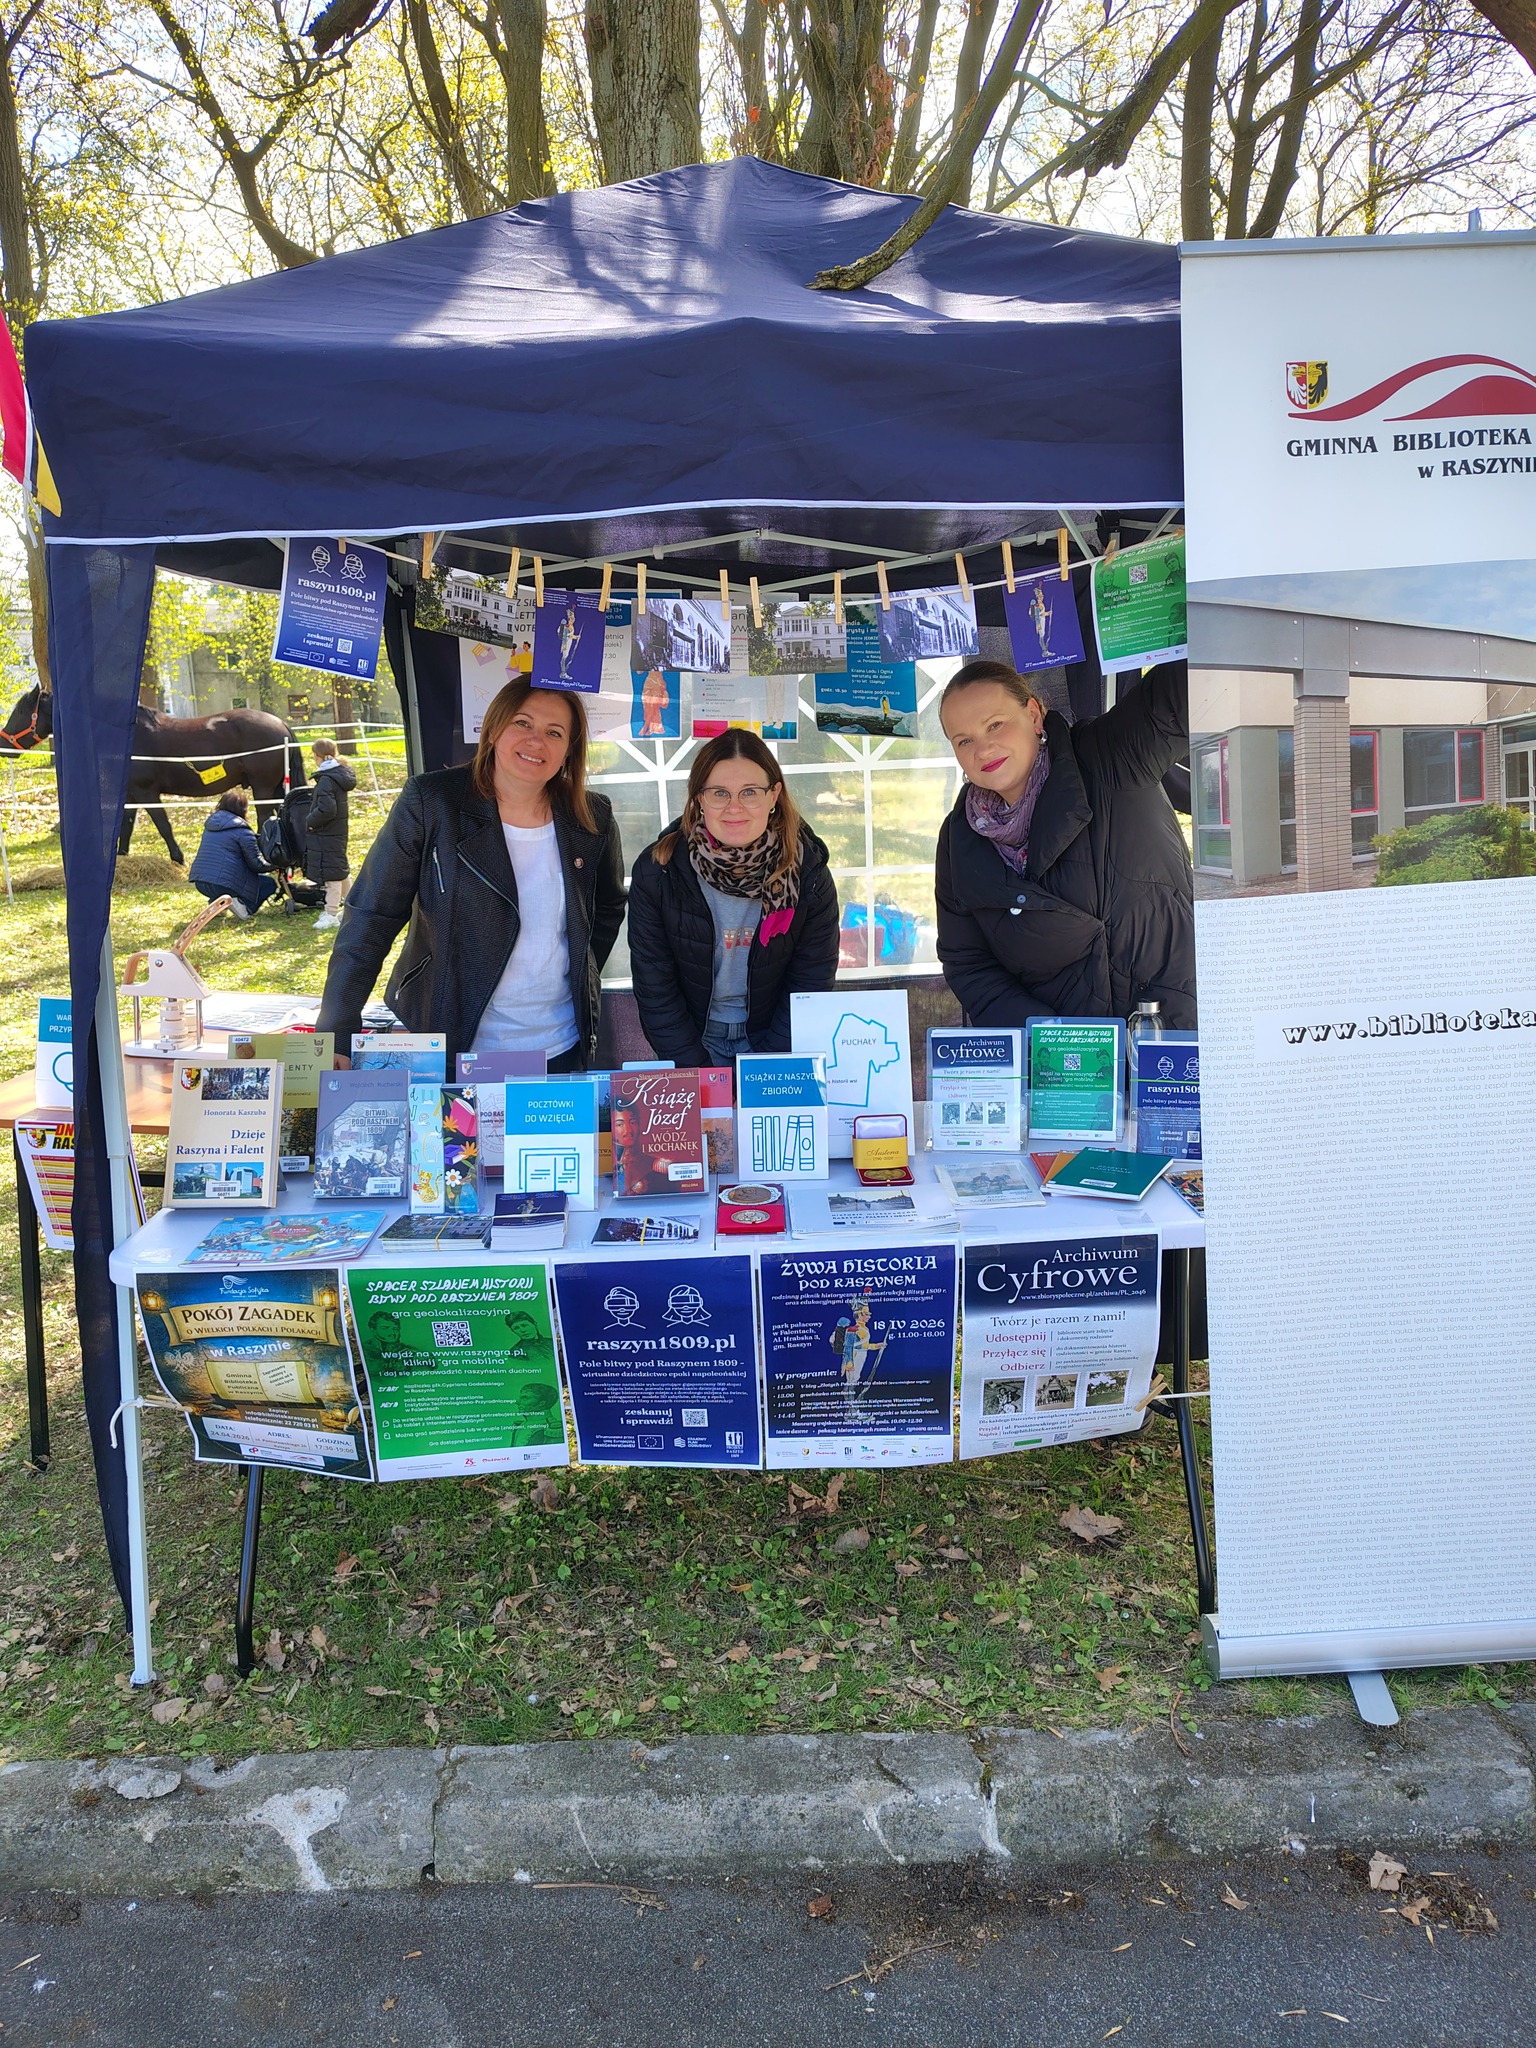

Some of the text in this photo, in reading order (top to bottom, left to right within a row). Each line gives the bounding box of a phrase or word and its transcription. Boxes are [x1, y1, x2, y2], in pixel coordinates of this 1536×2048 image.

[1287, 428, 1532, 456] GMINNA BIBLIOTEKA
[1418, 466, 1434, 478] w
[1111, 560, 1120, 569] gra
[298, 577, 376, 602] raszyn1809.pl
[303, 594, 319, 603] bitwy
[320, 597, 331, 605] pod
[333, 601, 360, 612] Raszynem
[307, 632, 334, 643] zeskanuj
[1282, 1008, 1536, 1044] www.biblioteka
[841, 1038, 877, 1046] PUCHAŁY
[967, 1039, 1005, 1047] Archiwum
[937, 1044, 1005, 1064] Cyfrowe
[1373, 1041, 1532, 1059] czasopisma relaks książki zasoby otwartość
[1213, 1054, 1335, 1071] audiobook partnerstwo biblioteka
[745, 1072, 776, 1082] KSIĄŻKI
[1203, 1072, 1234, 1081] dyskusja
[1262, 1069, 1285, 1077] kultura
[1288, 1066, 1311, 1077] zespół
[1314, 1062, 1348, 1073] biblioteka
[1367, 1065, 1464, 1078] komunikacja filmy dyskusja
[1241, 1073, 1338, 1088] animacja wiedza edukacja
[617, 1077, 695, 1108] Książę
[762, 1086, 802, 1095] ZBIORÓW
[528, 1100, 574, 1108] POCZTÓWKI
[366, 1117, 400, 1125] RASZYNEM
[525, 1113, 574, 1124] DO WZIĘCIA
[642, 1104, 691, 1135] Józef
[231, 1129, 266, 1140] Dzieje
[367, 1126, 383, 1134] 1809
[652, 1131, 687, 1143] WÓDZ
[176, 1144, 264, 1156] Raszyna i Falent
[648, 1141, 698, 1152] KOCHANEK
[1052, 1247, 1138, 1263] Archiwum
[781, 1255, 937, 1278] ŻYWA HISTORIA
[366, 1278, 533, 1292] SPACER SZLAKIEM HISTORII
[799, 1274, 917, 1291] POD RASZYNEM
[977, 1259, 1138, 1304] Cyfrowe
[410, 1293, 436, 1303] POD
[439, 1292, 506, 1303] RASZYNEM
[509, 1291, 538, 1301] 1809
[181, 1305, 316, 1324] POKÓJ ZAGADEK
[392, 1308, 511, 1319] gra geolokalizacyjna
[990, 1316, 1027, 1328] Twórz
[1031, 1316, 1041, 1328] je
[1045, 1314, 1079, 1324] razem
[1093, 1311, 1126, 1322] nami!
[194, 1326, 234, 1334] WIELKICH
[237, 1325, 272, 1333] POLKACH
[281, 1327, 320, 1336] POLAKACH
[873, 1319, 945, 1330] 18 IV 2026
[587, 1334, 736, 1354] raszyn1809.pl
[986, 1332, 1046, 1344] Udostępnij
[210, 1341, 291, 1357] w Raszynie
[787, 1341, 812, 1349] Raszyn
[381, 1351, 413, 1359] Wejdź
[982, 1349, 1028, 1360] Przyłącz
[1031, 1348, 1046, 1359] się
[403, 1358, 436, 1367] kliknij
[438, 1358, 459, 1366] "gra
[579, 1360, 601, 1368] Pole
[604, 1360, 632, 1369] bitwy
[635, 1360, 654, 1368] pod
[657, 1360, 710, 1368] Raszynem
[1001, 1362, 1045, 1371] Odbierz
[412, 1369, 462, 1377] poprowadzić
[692, 1370, 746, 1378] napoleońskiej
[786, 1369, 837, 1381] programie:
[625, 1408, 672, 1417] zeskanuj
[626, 1417, 673, 1426] sprawdź!
[317, 1437, 352, 1446] GODZINA:
